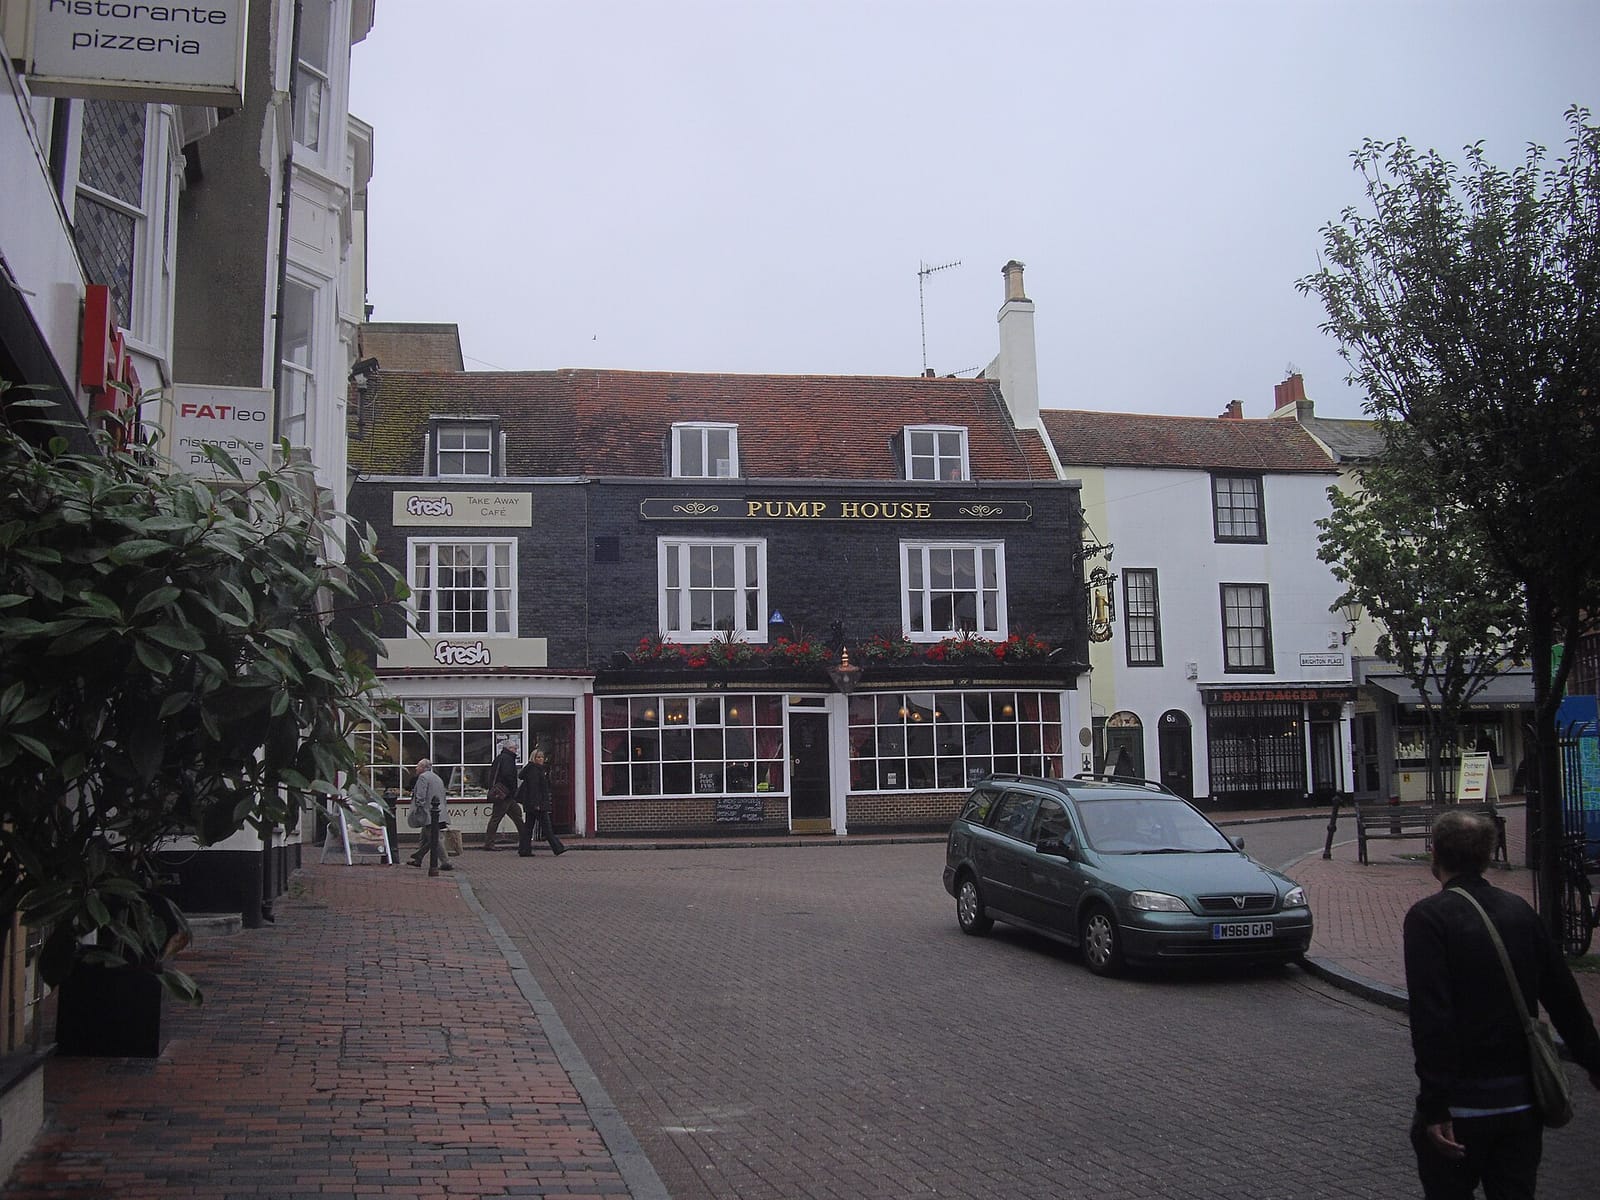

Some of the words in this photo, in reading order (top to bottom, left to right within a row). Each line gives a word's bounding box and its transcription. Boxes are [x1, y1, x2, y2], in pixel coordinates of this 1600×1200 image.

[50, 0, 226, 24] ristorante
[72, 29, 201, 54] pizzeria
[746, 501, 827, 518] PUMP
[840, 502, 932, 519] HOUSE
[1252, 923, 1272, 936] GAP
